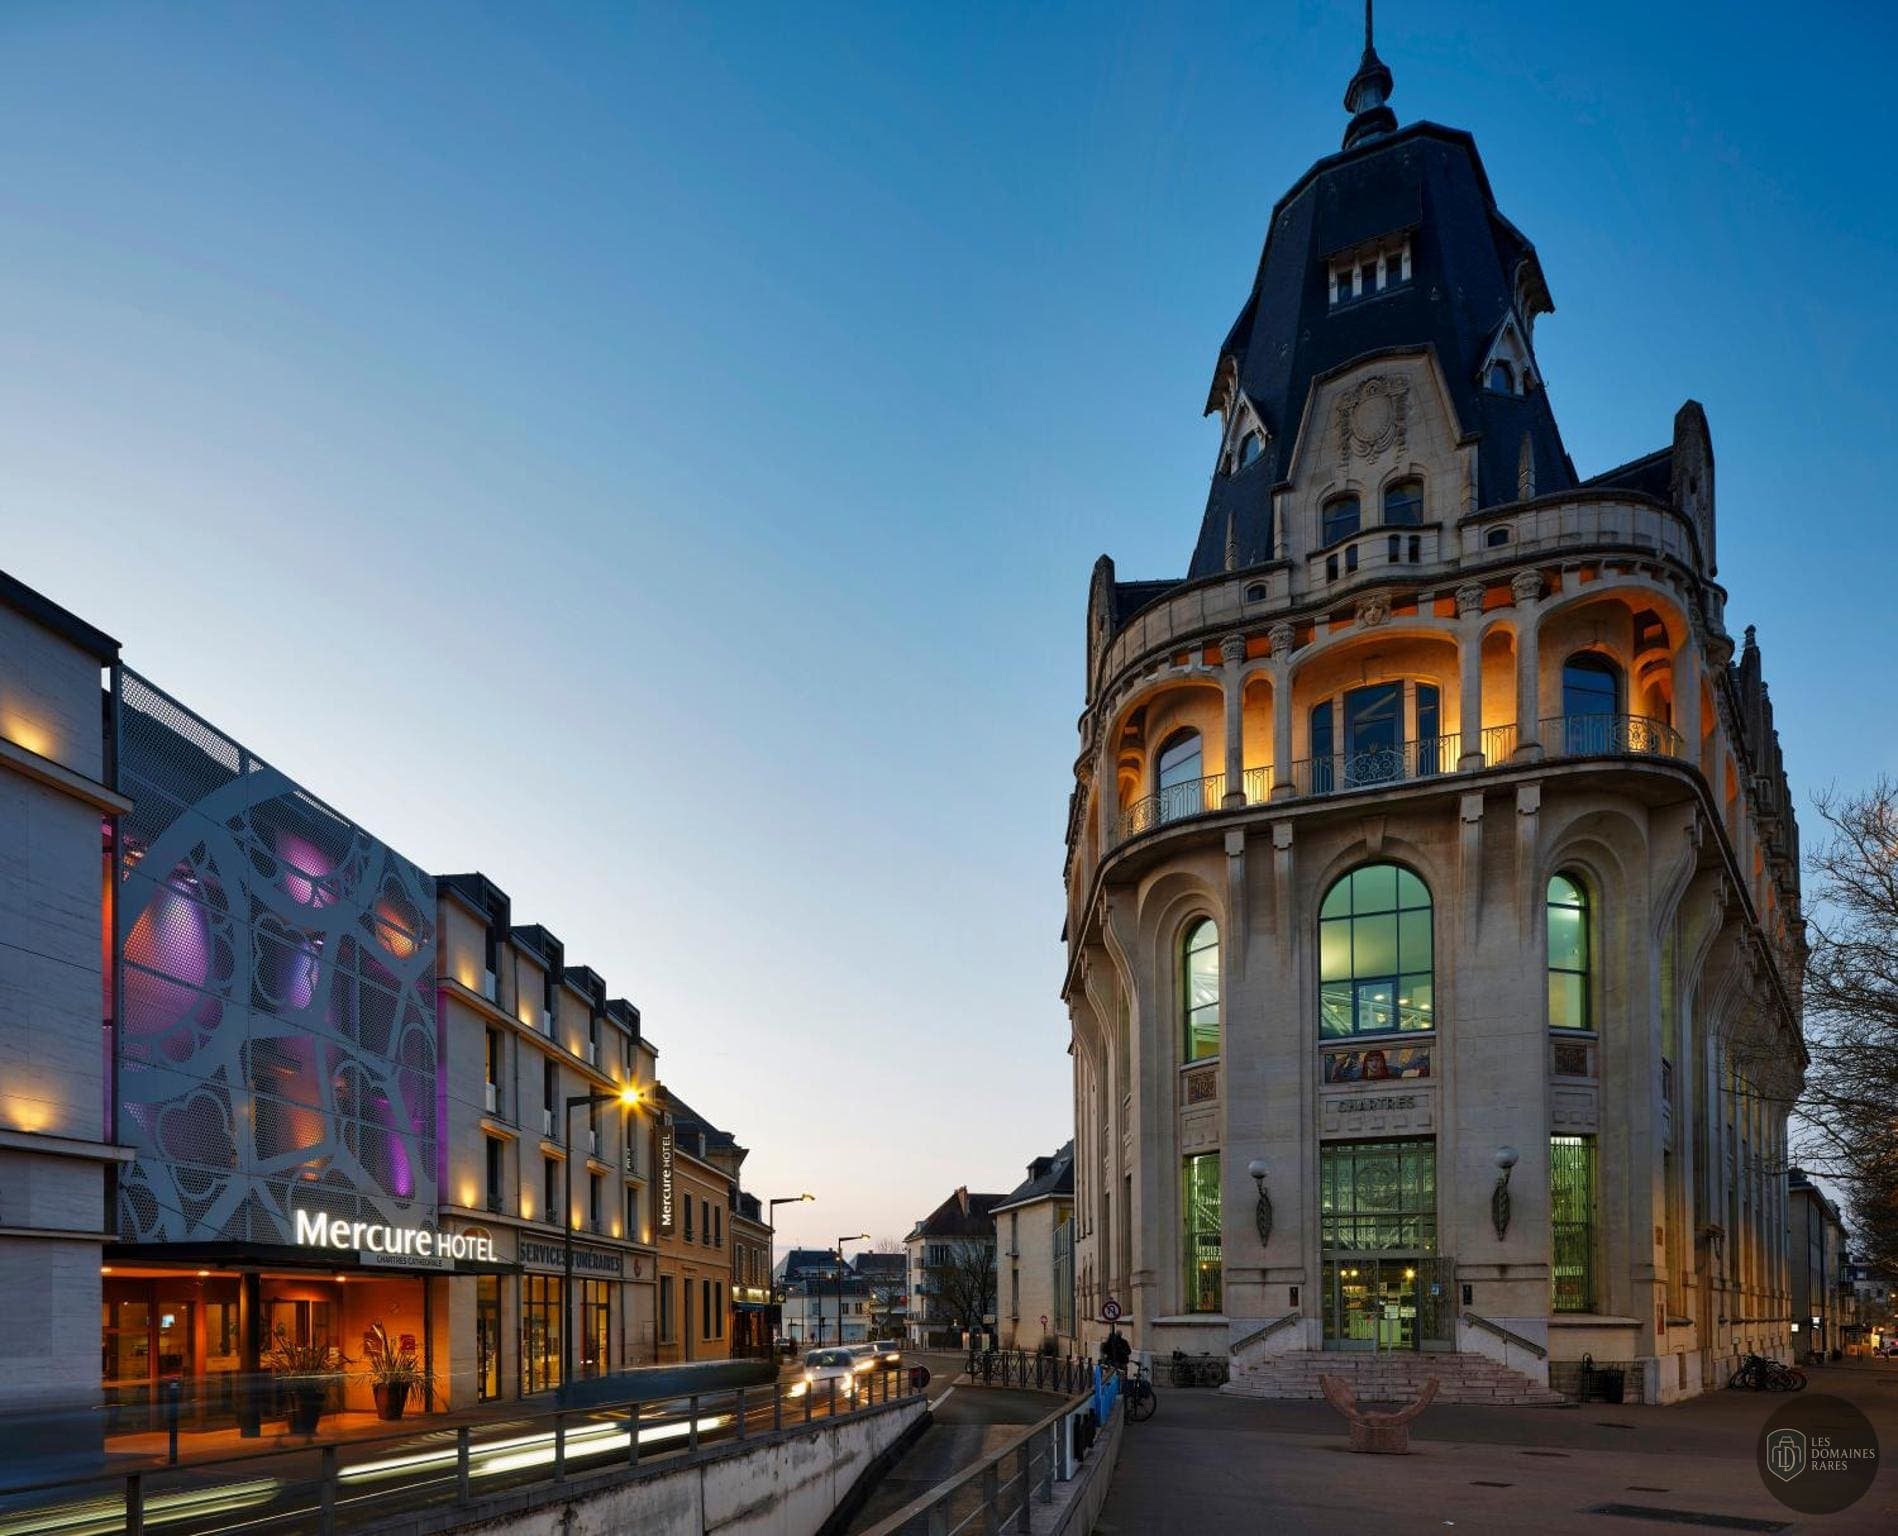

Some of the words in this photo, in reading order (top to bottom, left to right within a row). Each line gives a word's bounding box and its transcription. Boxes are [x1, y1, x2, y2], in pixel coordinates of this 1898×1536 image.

[1338, 1096, 1416, 1113] CHARTRES
[662, 1133, 671, 1168] HOTEL
[661, 1169, 672, 1226] Mercure
[296, 1209, 433, 1257] Mercure
[437, 1232, 498, 1262] HOTEL
[519, 1242, 567, 1267] SERVICES
